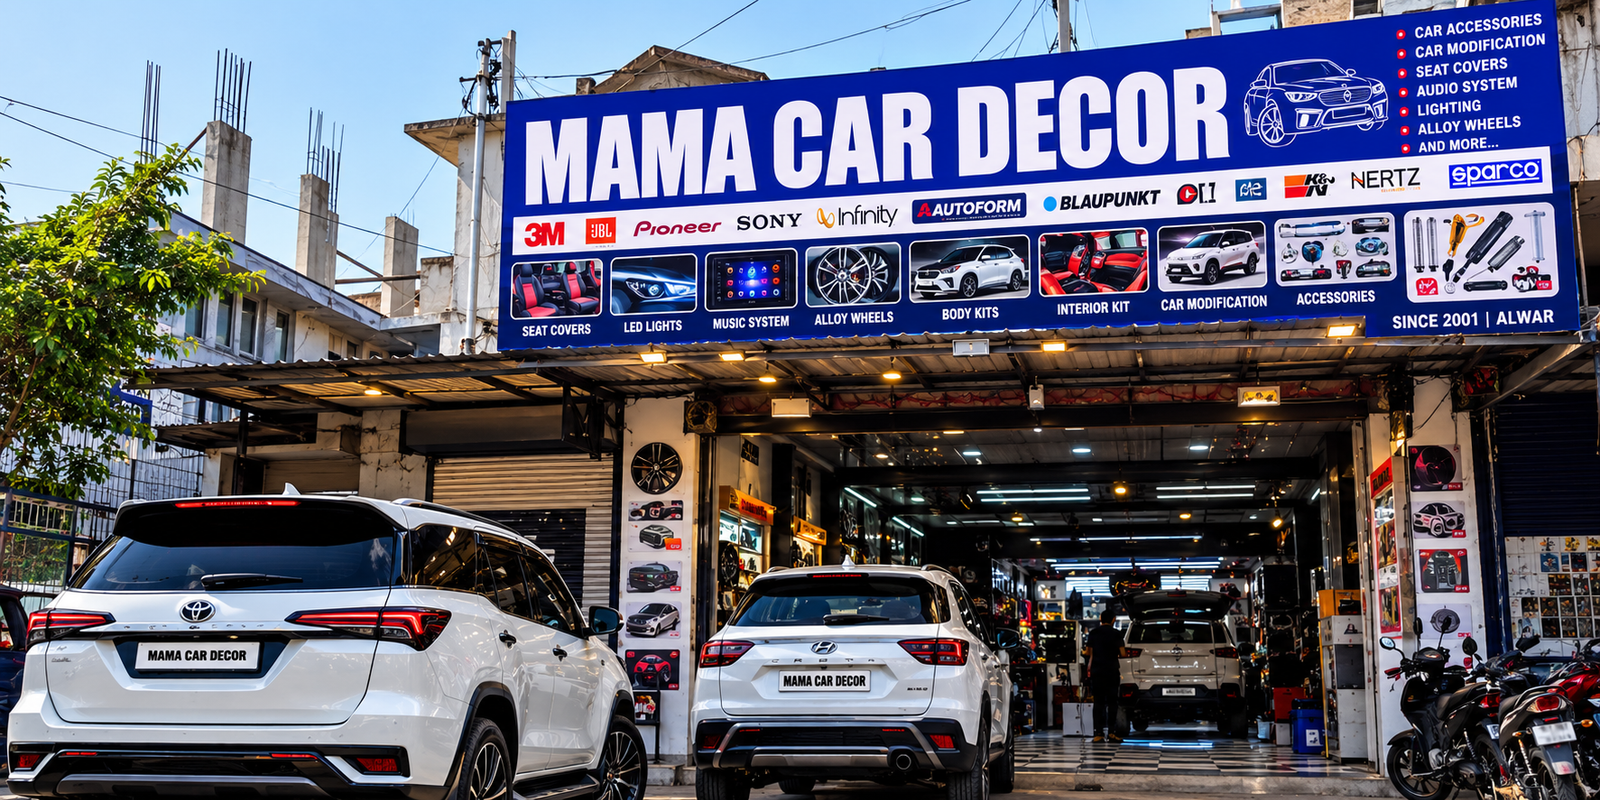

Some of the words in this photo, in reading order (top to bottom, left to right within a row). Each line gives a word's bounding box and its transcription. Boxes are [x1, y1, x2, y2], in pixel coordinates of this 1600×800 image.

[1415, 24, 1442, 38] CAR
[1446, 13, 1542, 36] ACCESSORIES
[1415, 44, 1443, 58] CAR
[1447, 33, 1546, 55] MODIFICATION
[1416, 63, 1450, 78] SEAT
[1453, 58, 1508, 74] COVERS
[1416, 82, 1458, 97] AUDIO
[1462, 76, 1518, 93] SYSTEM
[1418, 100, 1482, 116] LIGHTING
[1418, 120, 1460, 136] ALLOY
[1464, 116, 1522, 132] WHEELS
[524, 105, 756, 206] MAMA
[773, 92, 934, 189] CAR
[958, 66, 1230, 177] DECOR
[1418, 140, 1446, 153] AND
[1450, 137, 1498, 151] MORE...
[1452, 161, 1540, 187] sparco
[1060, 190, 1160, 210] BLAUPUNKT
[737, 213, 802, 230] SONY
[838, 204, 898, 228] Infinity
[524, 222, 565, 247] 3M
[591, 223, 612, 238] JBL
[633, 220, 722, 237] Pioneer
[1161, 298, 1184, 311] CAR
[1187, 295, 1268, 310] MODIFICATION
[1296, 290, 1376, 305] ACCESSORIES
[942, 308, 972, 320] BODY
[974, 306, 999, 318] KITS
[1057, 302, 1109, 315] INTERIOR
[1112, 300, 1130, 313] KIT
[624, 321, 643, 332] LED
[646, 320, 682, 332] LIGHTS
[713, 318, 744, 329] MUSIC
[748, 316, 790, 328] SYSTEM
[814, 313, 848, 326] ALLOY
[850, 311, 894, 324] WHEELS
[1392, 314, 1438, 329] SINCE
[1442, 312, 1478, 328] 2001
[1496, 309, 1554, 326] ALWAR
[522, 325, 548, 336] SEAT
[550, 324, 591, 336] COVERS
[148, 650, 182, 661] MAMA
[184, 650, 207, 661] CAR
[210, 650, 246, 661] DECOR
[783, 676, 812, 686] MAMA
[814, 676, 833, 686] CAR
[836, 676, 866, 686] DECOR
